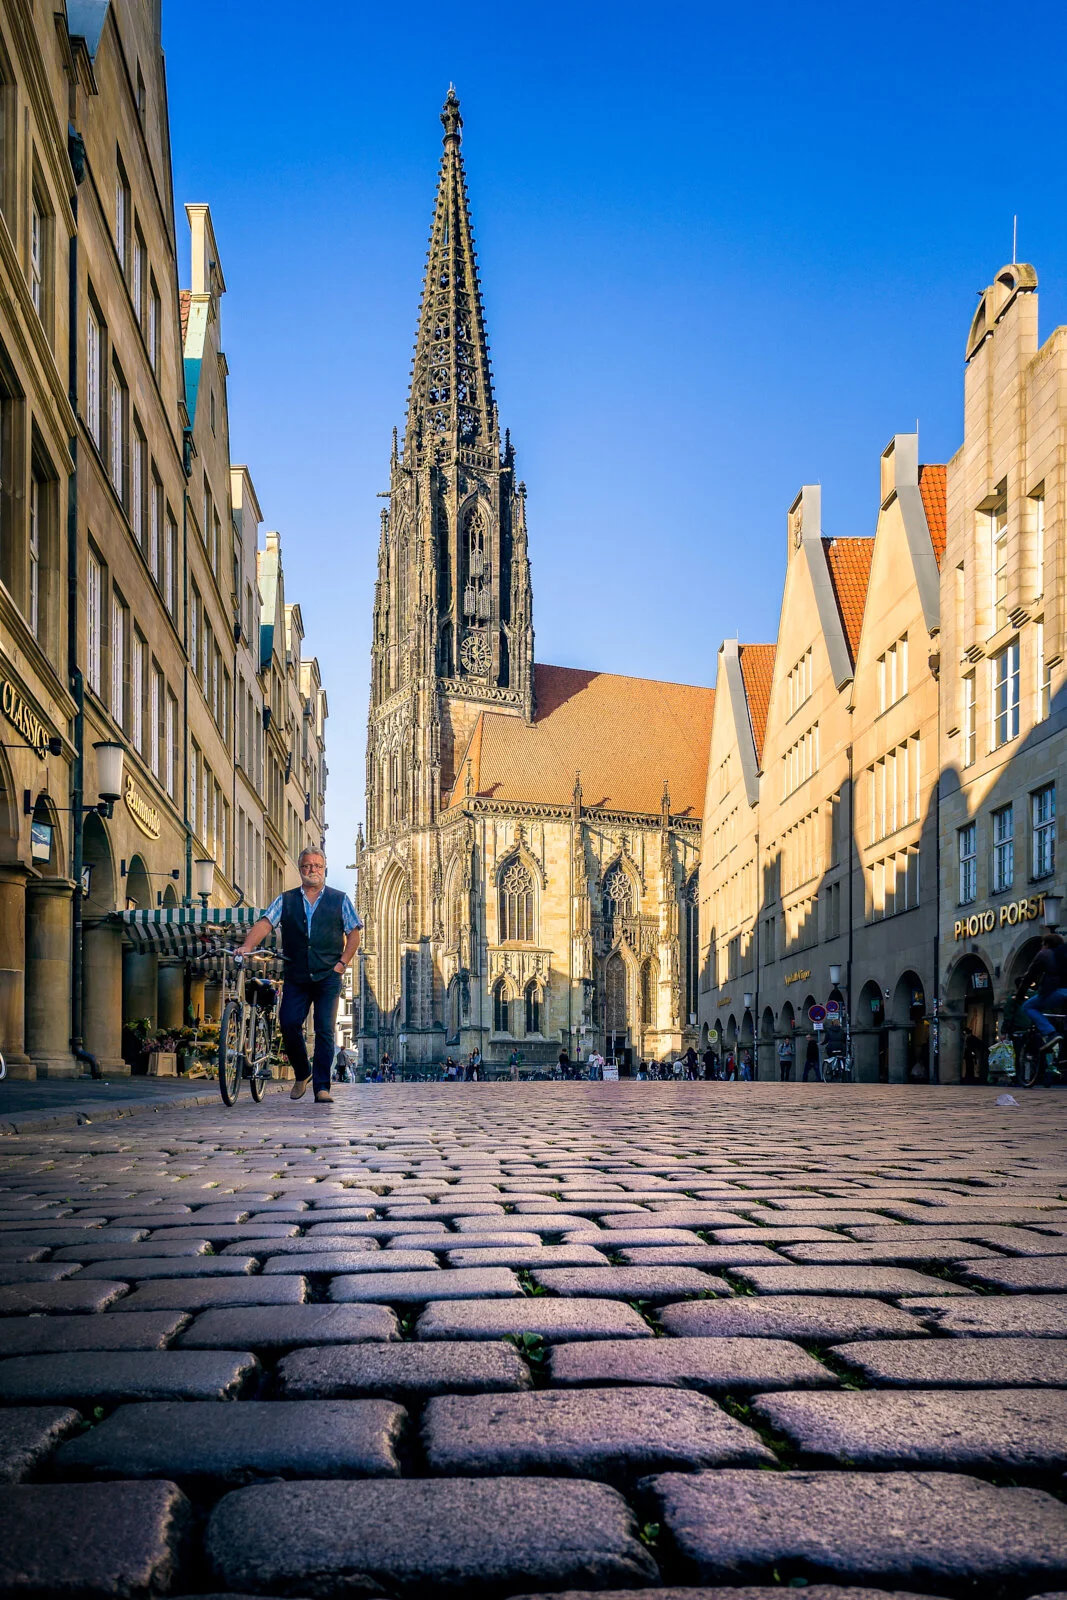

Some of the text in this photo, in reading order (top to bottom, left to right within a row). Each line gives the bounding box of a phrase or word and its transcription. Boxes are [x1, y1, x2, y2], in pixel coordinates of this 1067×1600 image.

[3, 681, 49, 760] CLASSICS
[954, 892, 1047, 940] PHOTO PORST
